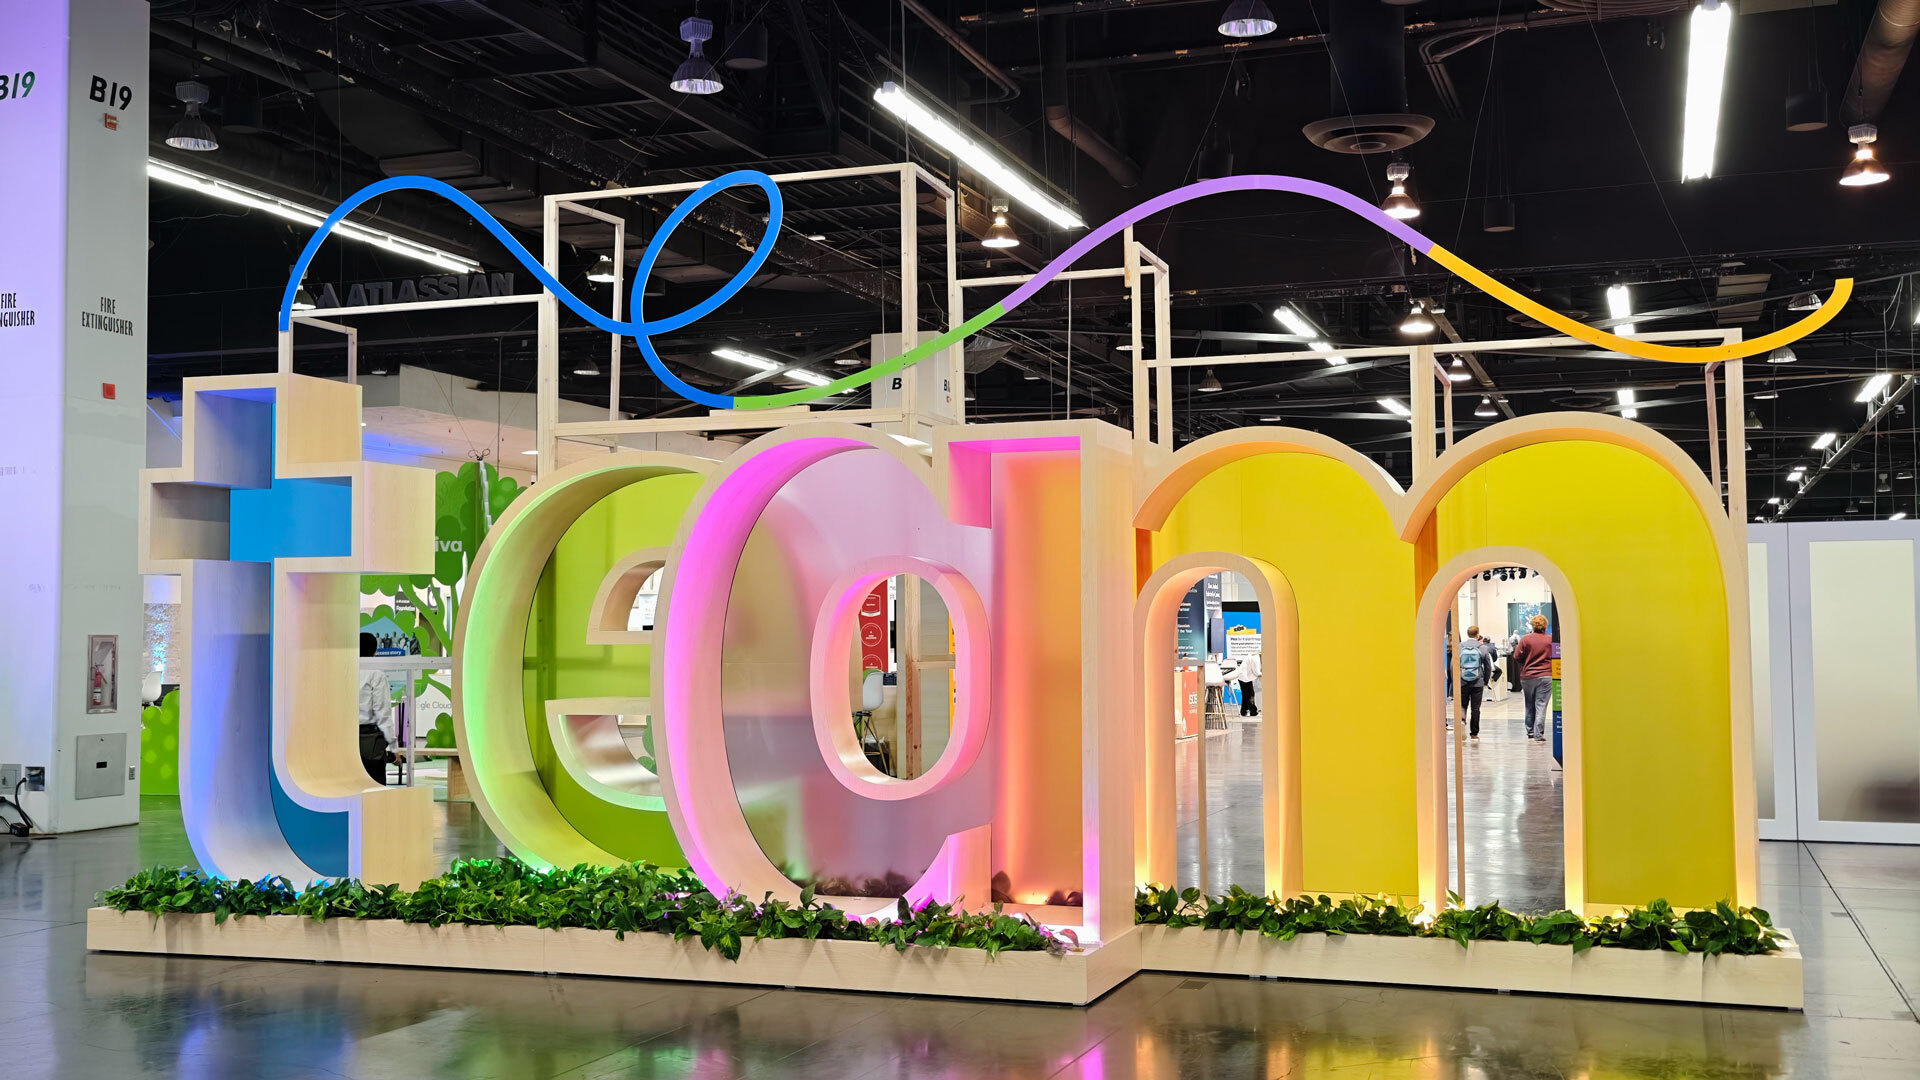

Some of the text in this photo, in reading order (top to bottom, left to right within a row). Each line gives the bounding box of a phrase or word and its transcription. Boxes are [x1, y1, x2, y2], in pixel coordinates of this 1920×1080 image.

[346, 272, 515, 307] ATLASSIAN
[0, 292, 17, 309] FIRE
[100, 296, 116, 314] FIRE
[81, 311, 134, 336] EXTINGUISHER
[434, 536, 463, 552] iva
